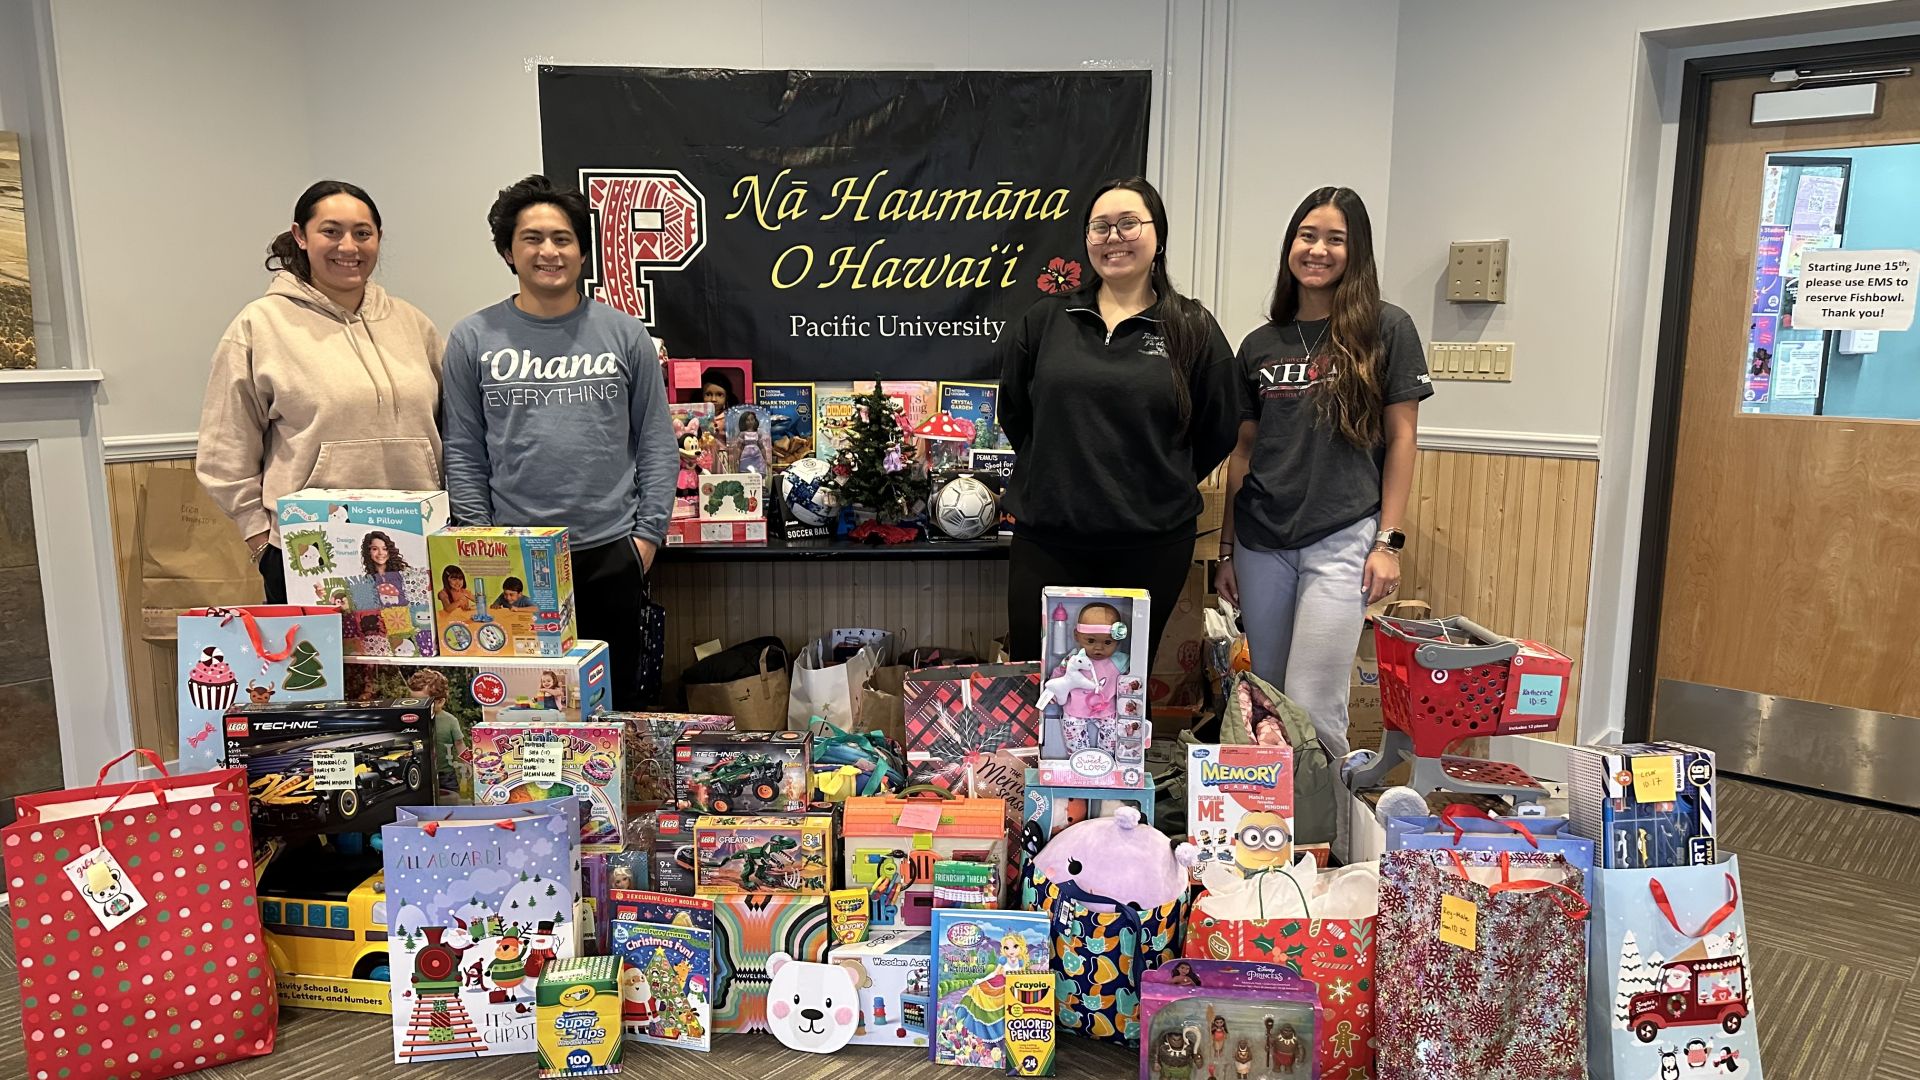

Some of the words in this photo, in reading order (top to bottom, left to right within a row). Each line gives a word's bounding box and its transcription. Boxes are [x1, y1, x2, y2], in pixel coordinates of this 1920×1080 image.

[821, 169, 1071, 223] Haumāna
[771, 244, 814, 289] O
[1808, 263, 1852, 273] Starting
[1854, 263, 1881, 271] June
[1805, 278, 1842, 288] please
[1867, 278, 1893, 286] EMS
[1850, 293, 1904, 302] Fishbowl.
[1822, 309, 1855, 317] Thank
[1858, 309, 1884, 319] you!
[790, 315, 871, 338] Pacific
[876, 315, 1006, 343] University
[486, 383, 618, 407] EVERYTHING
[826, 404, 852, 416] DUMBO
[351, 506, 384, 514] No-Sew
[386, 507, 419, 515] Blanket
[787, 529, 814, 539] SOCCER
[814, 527, 830, 536] BALL
[483, 676, 499, 684] Indoor
[477, 693, 497, 703] Outdoor
[227, 723, 247, 731] LEGO
[253, 721, 319, 731] TECHNIC
[1010, 768, 1022, 778] THE
[1202, 761, 1282, 784] MEMORY
[1692, 766, 1704, 781] 16
[1198, 801, 1225, 821] ME
[661, 820, 679, 828] LEGO
[396, 855, 422, 869] ALL
[427, 847, 502, 869] ABOARD!
[935, 873, 965, 882] FRIENDSHIP
[966, 875, 987, 883] THREAD
[836, 899, 862, 907] Crayola
[619, 912, 636, 920] LEGO
[835, 922, 865, 932] CRAYONS
[626, 937, 673, 951] Christmas
[675, 941, 695, 959] Fun!
[873, 957, 908, 966] Wooden
[1247, 971, 1283, 981] PRINCESS
[303, 984, 330, 992] School
[333, 986, 348, 994] Bus
[1014, 981, 1047, 990] Crayola
[291, 992, 325, 1001] Letters,
[326, 995, 343, 1003] and
[345, 996, 383, 1005] Numbers
[486, 1011, 513, 1027] IT'S
[555, 1017, 599, 1029] Super
[1007, 1018, 1053, 1030] COLORED
[577, 1027, 606, 1040] Tips
[1010, 1030, 1051, 1042] PENCILS
[568, 1055, 590, 1065] 100
[1024, 1058, 1037, 1068] 24
